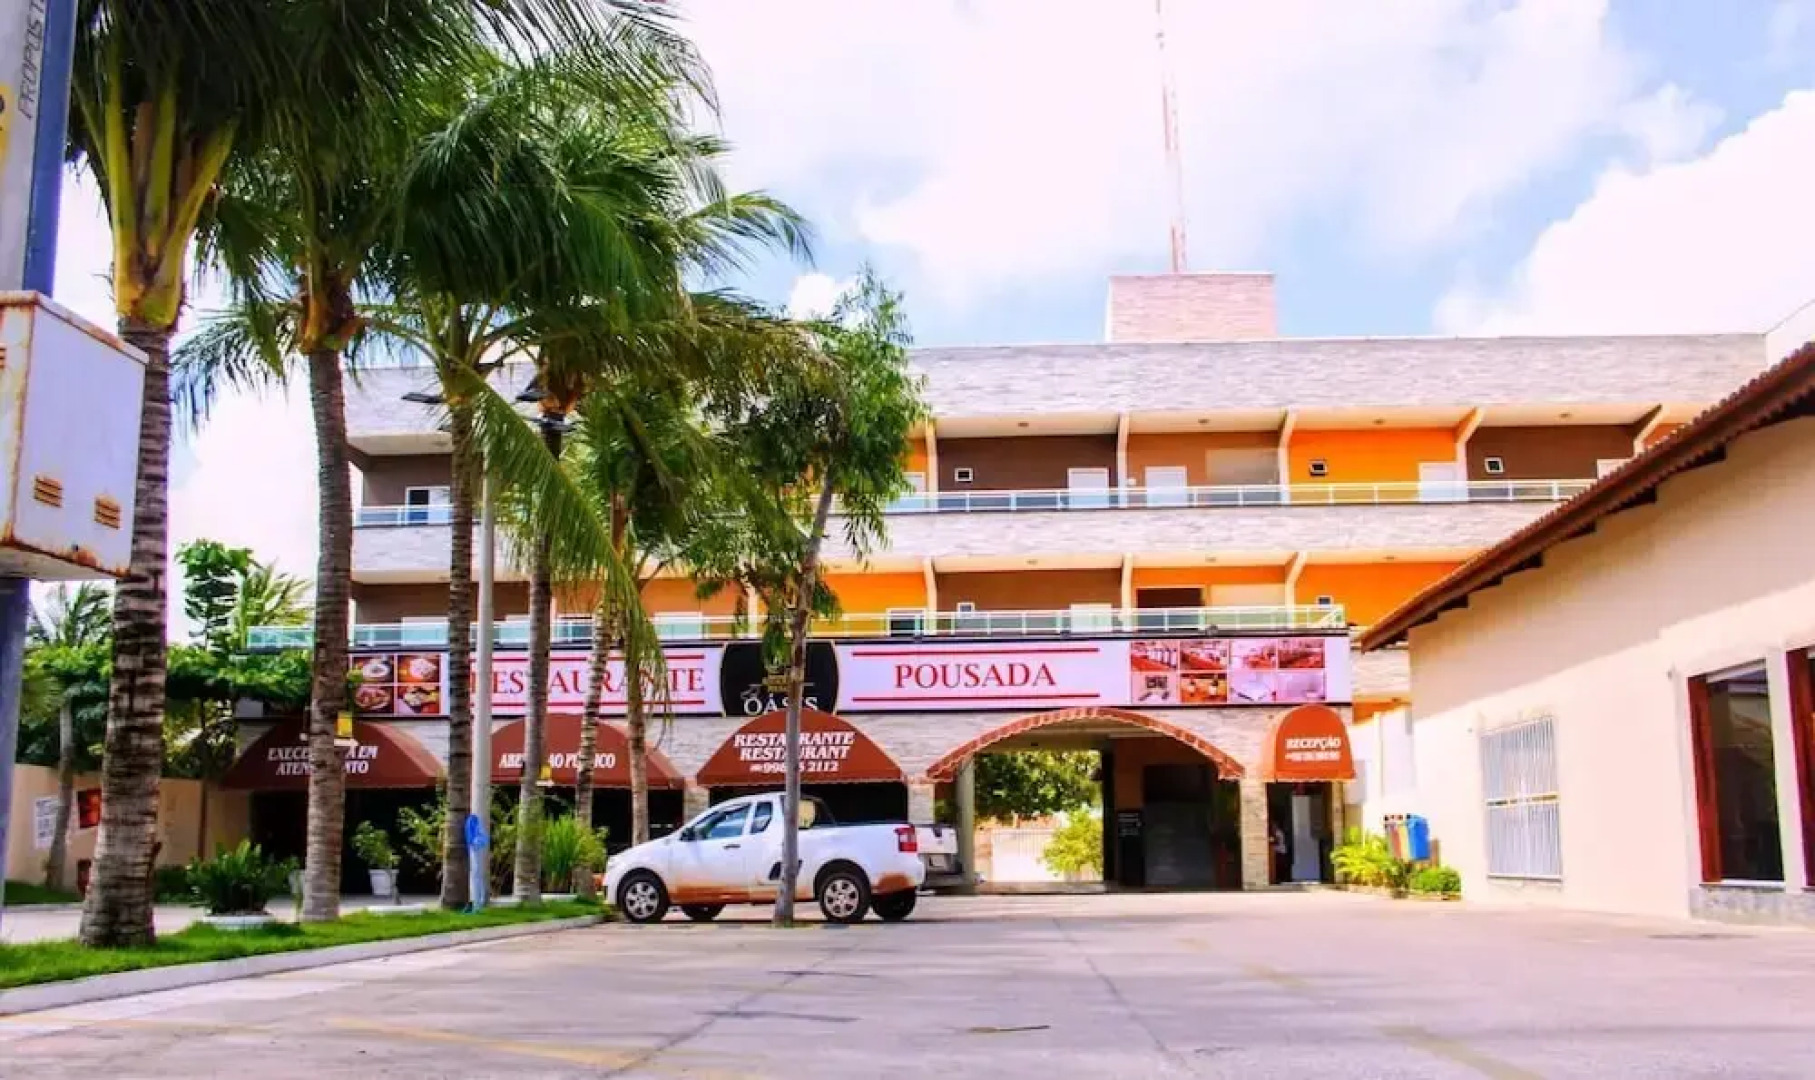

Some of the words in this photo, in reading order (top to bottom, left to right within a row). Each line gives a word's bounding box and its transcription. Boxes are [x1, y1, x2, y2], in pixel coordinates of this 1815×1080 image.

[18, 0, 45, 119] PROPOST
[469, 666, 705, 694] ESAURTE
[894, 662, 1056, 688] POUSADA
[743, 693, 819, 715] OÁS
[733, 731, 855, 747] RESTARANTE
[740, 745, 850, 761] RESTRANT
